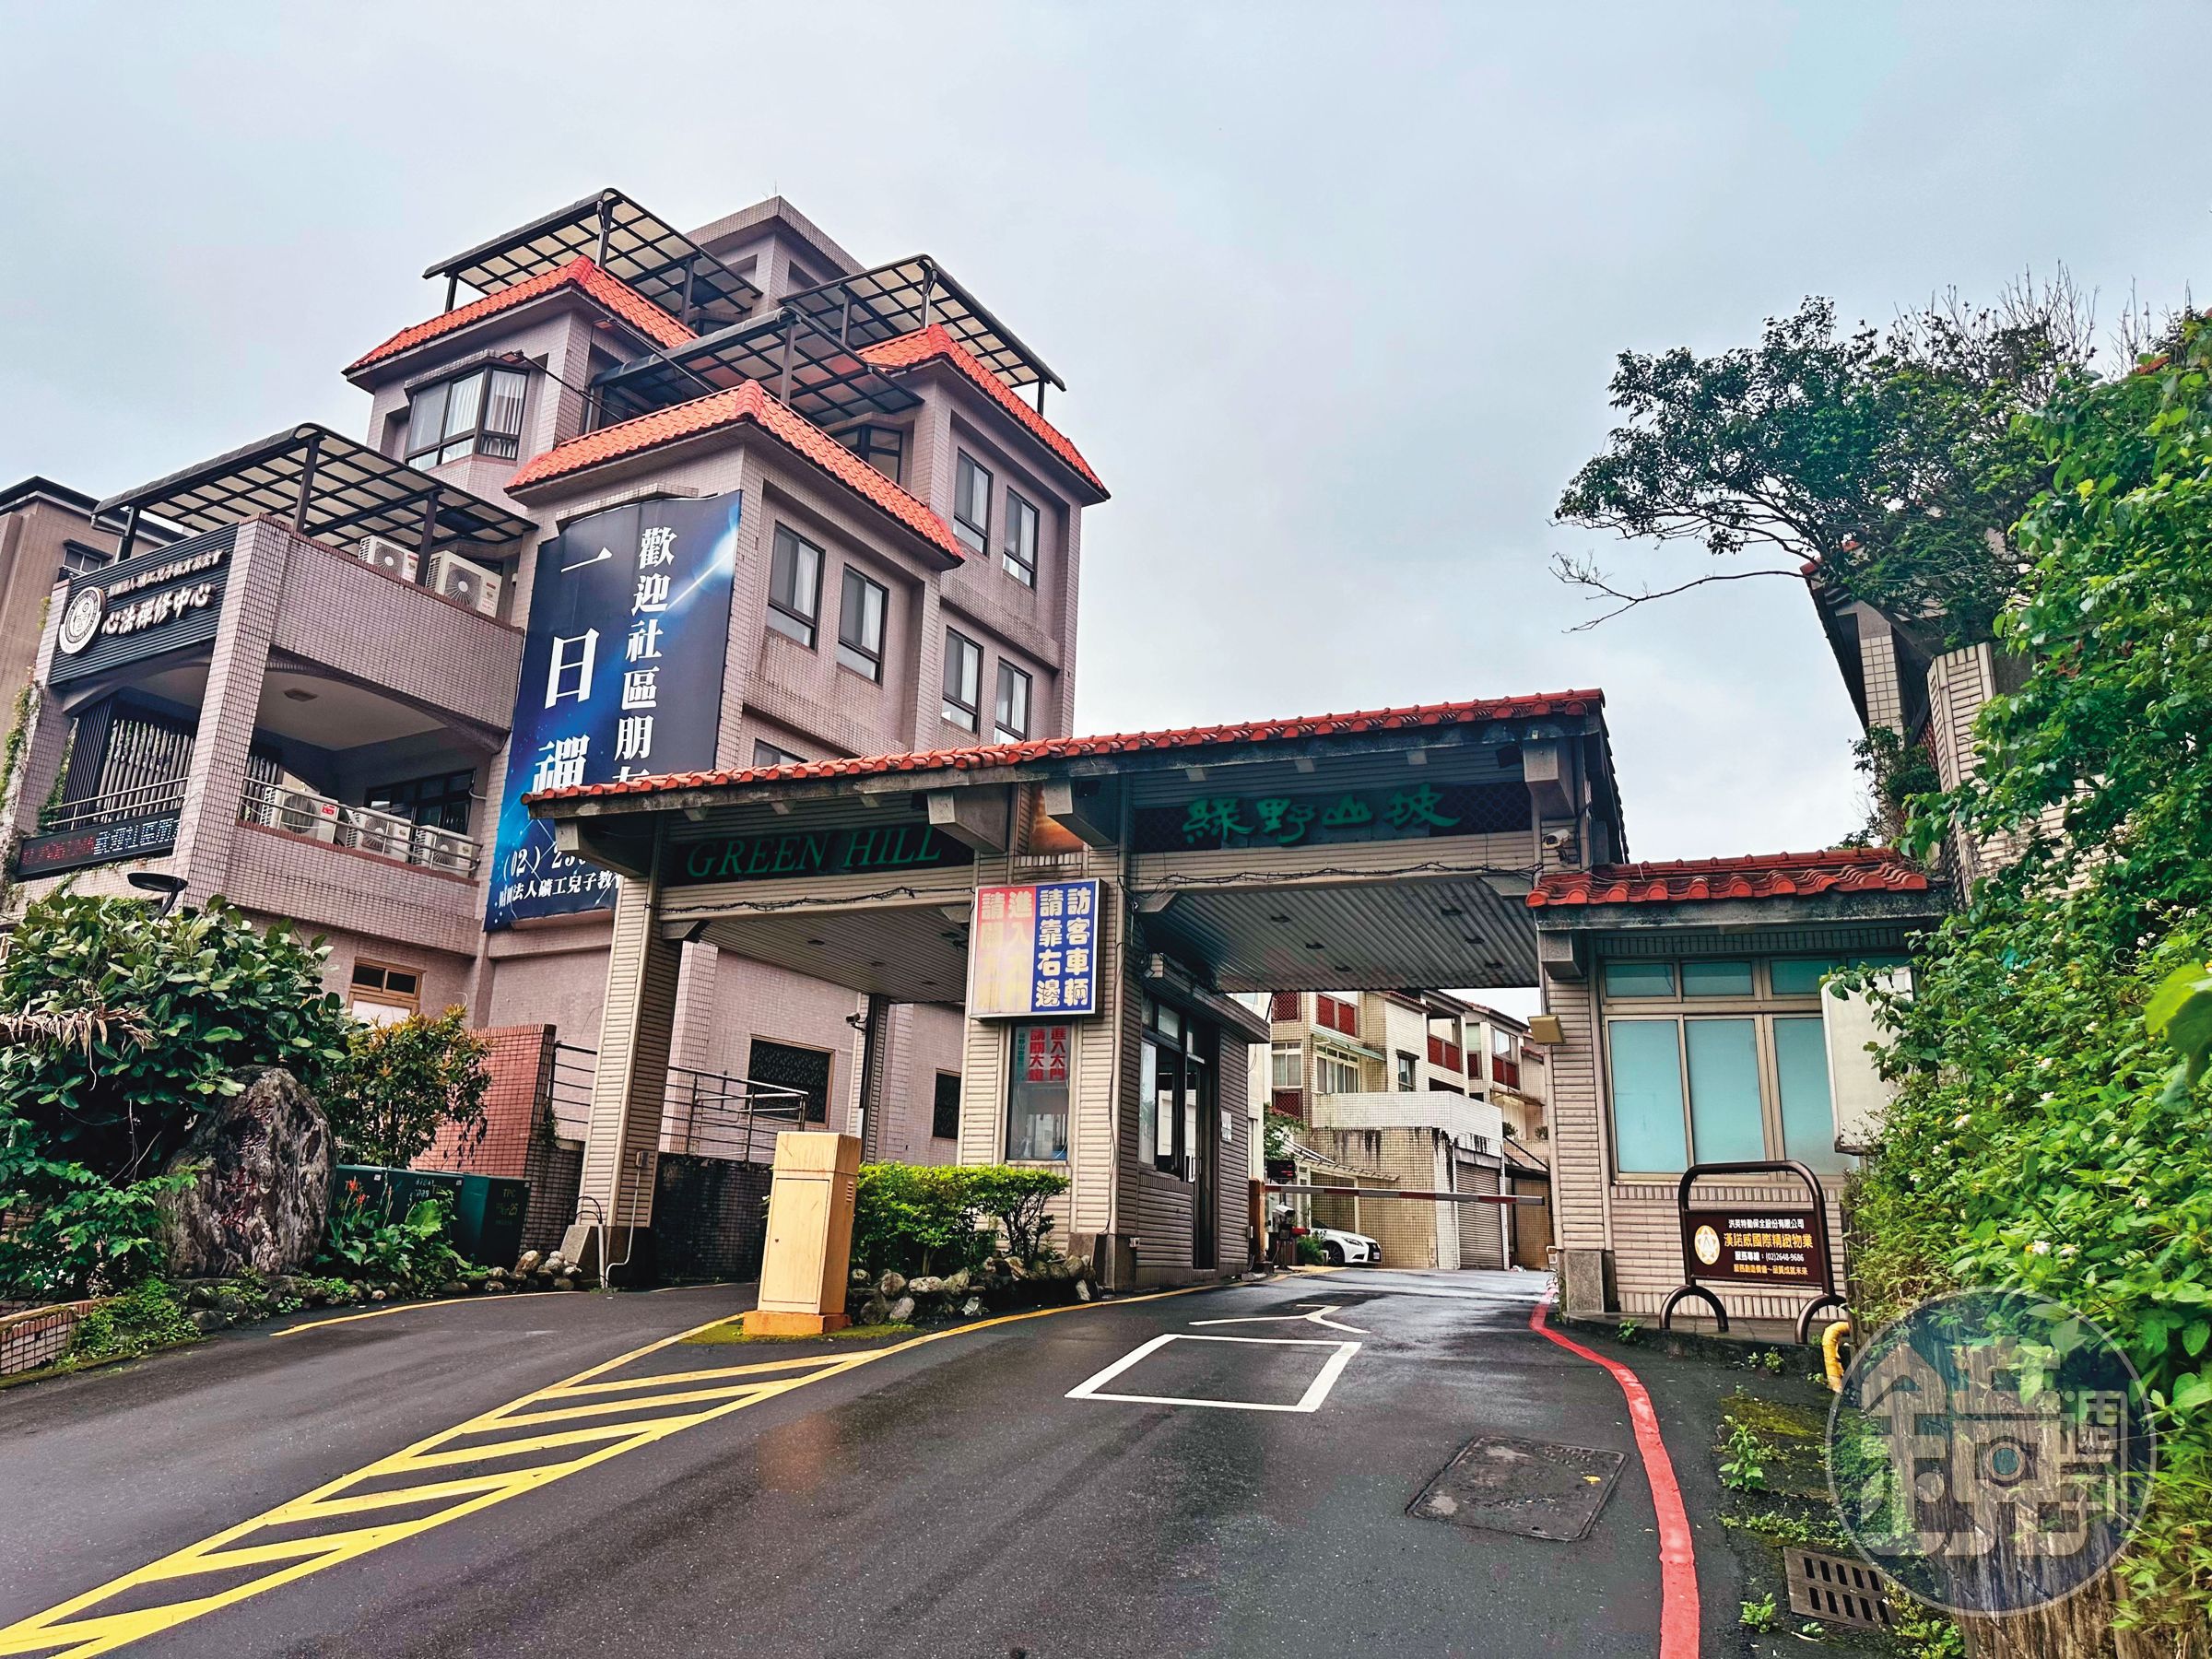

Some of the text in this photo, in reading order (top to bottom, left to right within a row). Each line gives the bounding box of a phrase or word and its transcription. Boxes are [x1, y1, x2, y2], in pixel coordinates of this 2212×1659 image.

[100, 582, 216, 635] 心法禪修中心
[1182, 783, 1462, 844] 綠野山坡
[686, 826, 942, 876] GREEN HILL
[1035, 888, 1064, 1008] 請靠右邊
[1064, 887, 1091, 1007] 訪客車輛
[1049, 1027, 1066, 1081] 進入大門
